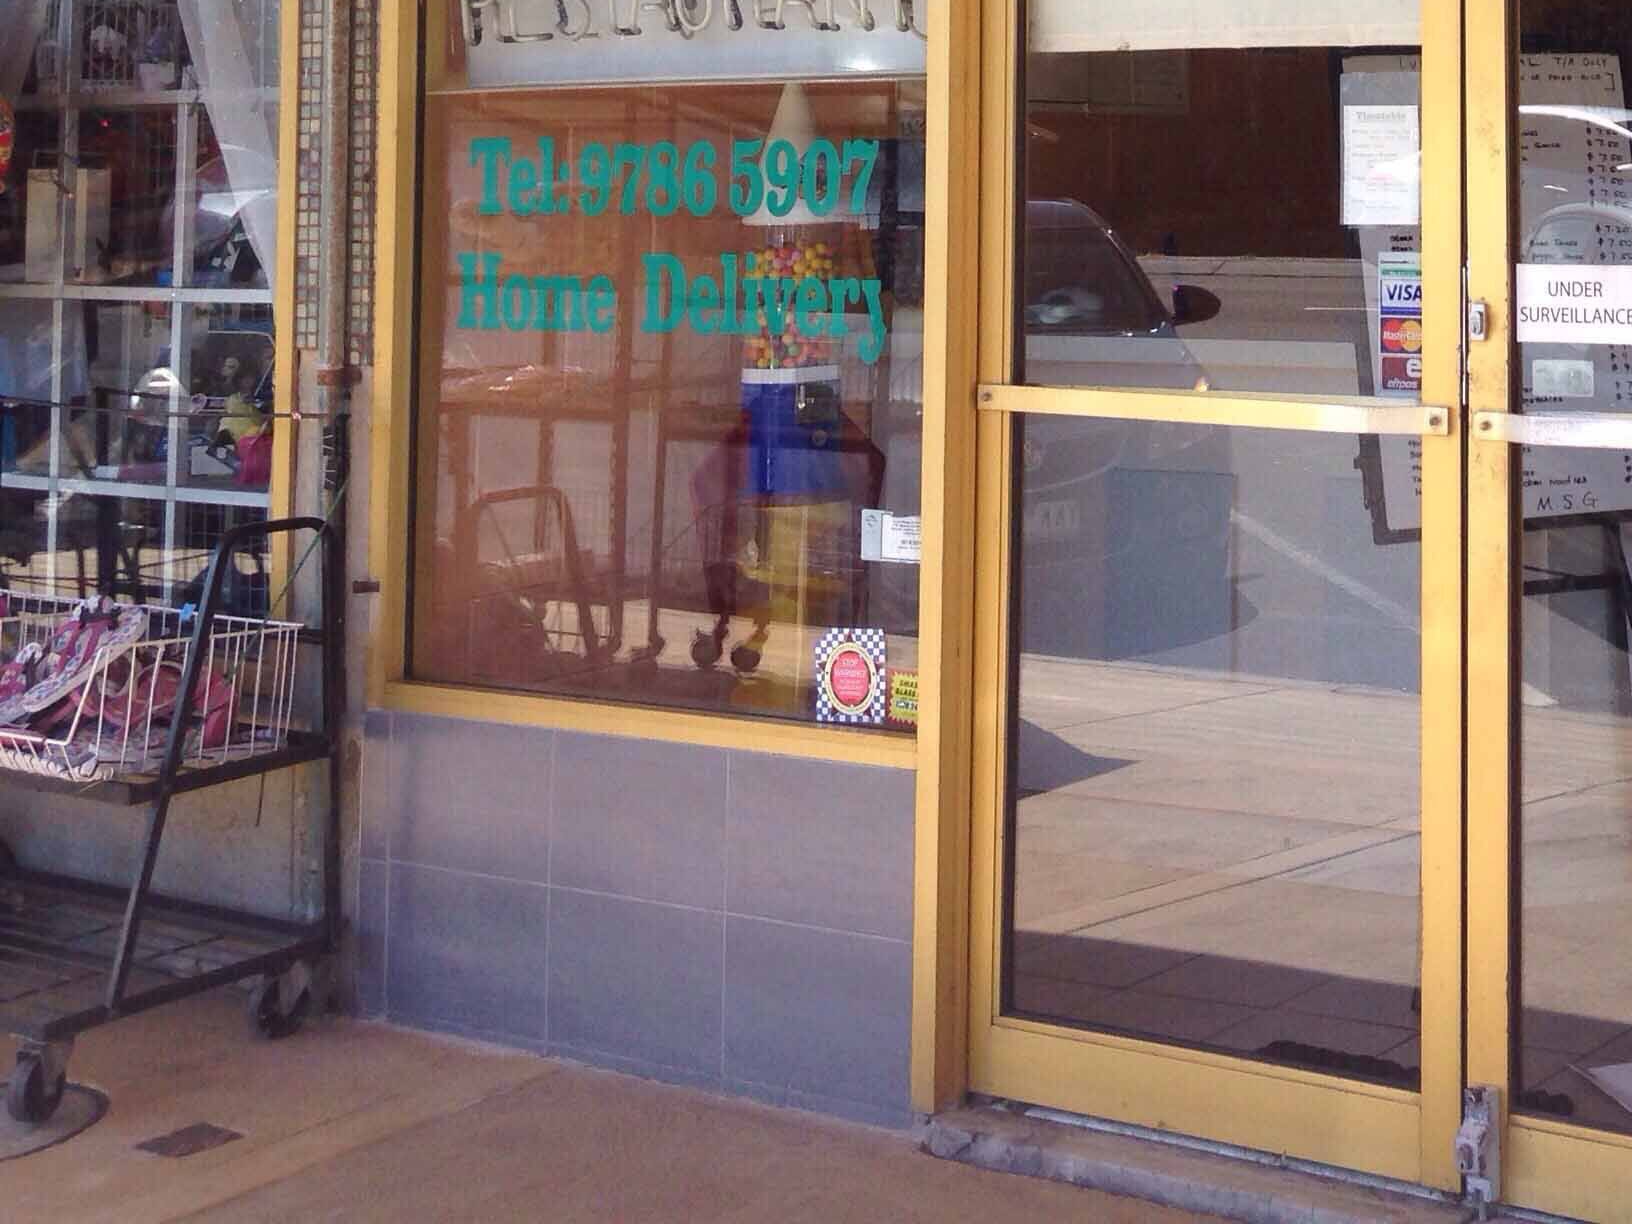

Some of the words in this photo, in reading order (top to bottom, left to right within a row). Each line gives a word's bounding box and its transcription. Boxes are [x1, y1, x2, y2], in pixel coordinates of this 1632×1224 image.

[729, 138, 881, 218] 5907
[457, 253, 616, 334] Home
[640, 253, 889, 364] Delivery
[1386, 283, 1422, 301] VISA
[1547, 280, 1604, 298] UNDER
